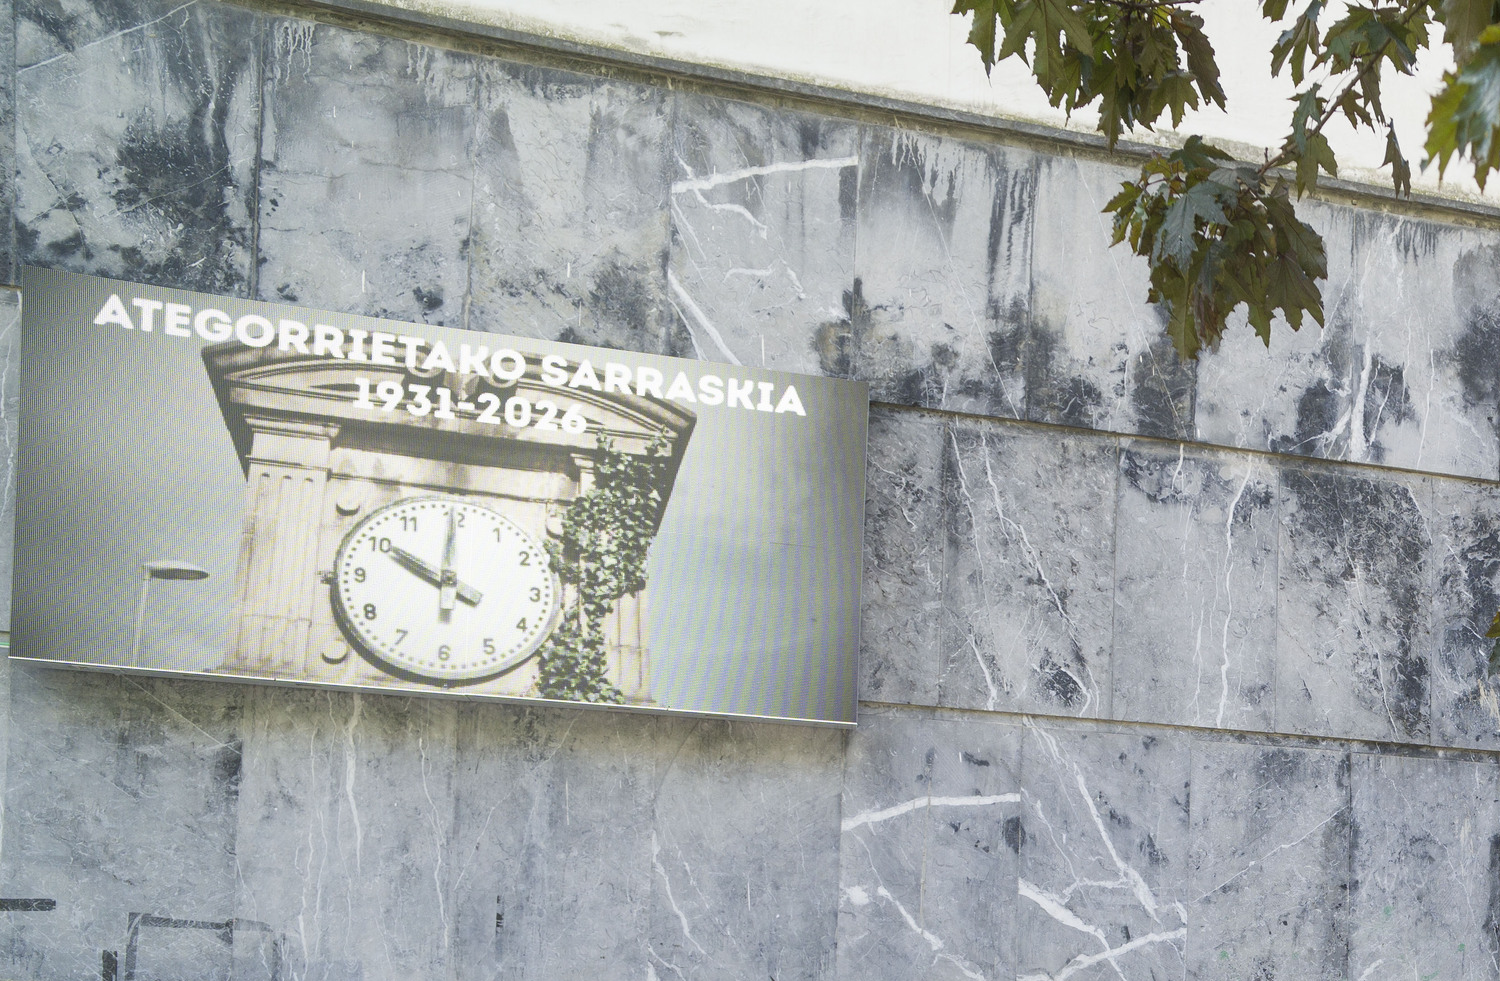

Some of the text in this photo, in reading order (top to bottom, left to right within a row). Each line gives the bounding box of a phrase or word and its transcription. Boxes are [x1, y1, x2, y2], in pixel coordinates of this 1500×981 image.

[93, 294, 806, 417] ATEGORRIETAKO SARRASKIA
[353, 377, 588, 435] 1931-2026
[400, 516, 417, 532] 11
[493, 527, 501, 543] 1
[368, 536, 392, 554] 10
[519, 551, 531, 566] 2
[354, 567, 366, 583] 9
[529, 587, 541, 603] 3
[363, 603, 377, 620] 8
[516, 617, 527, 632] 4
[395, 628, 408, 646] 7
[438, 645, 450, 661] 6
[483, 638, 495, 655] 5
